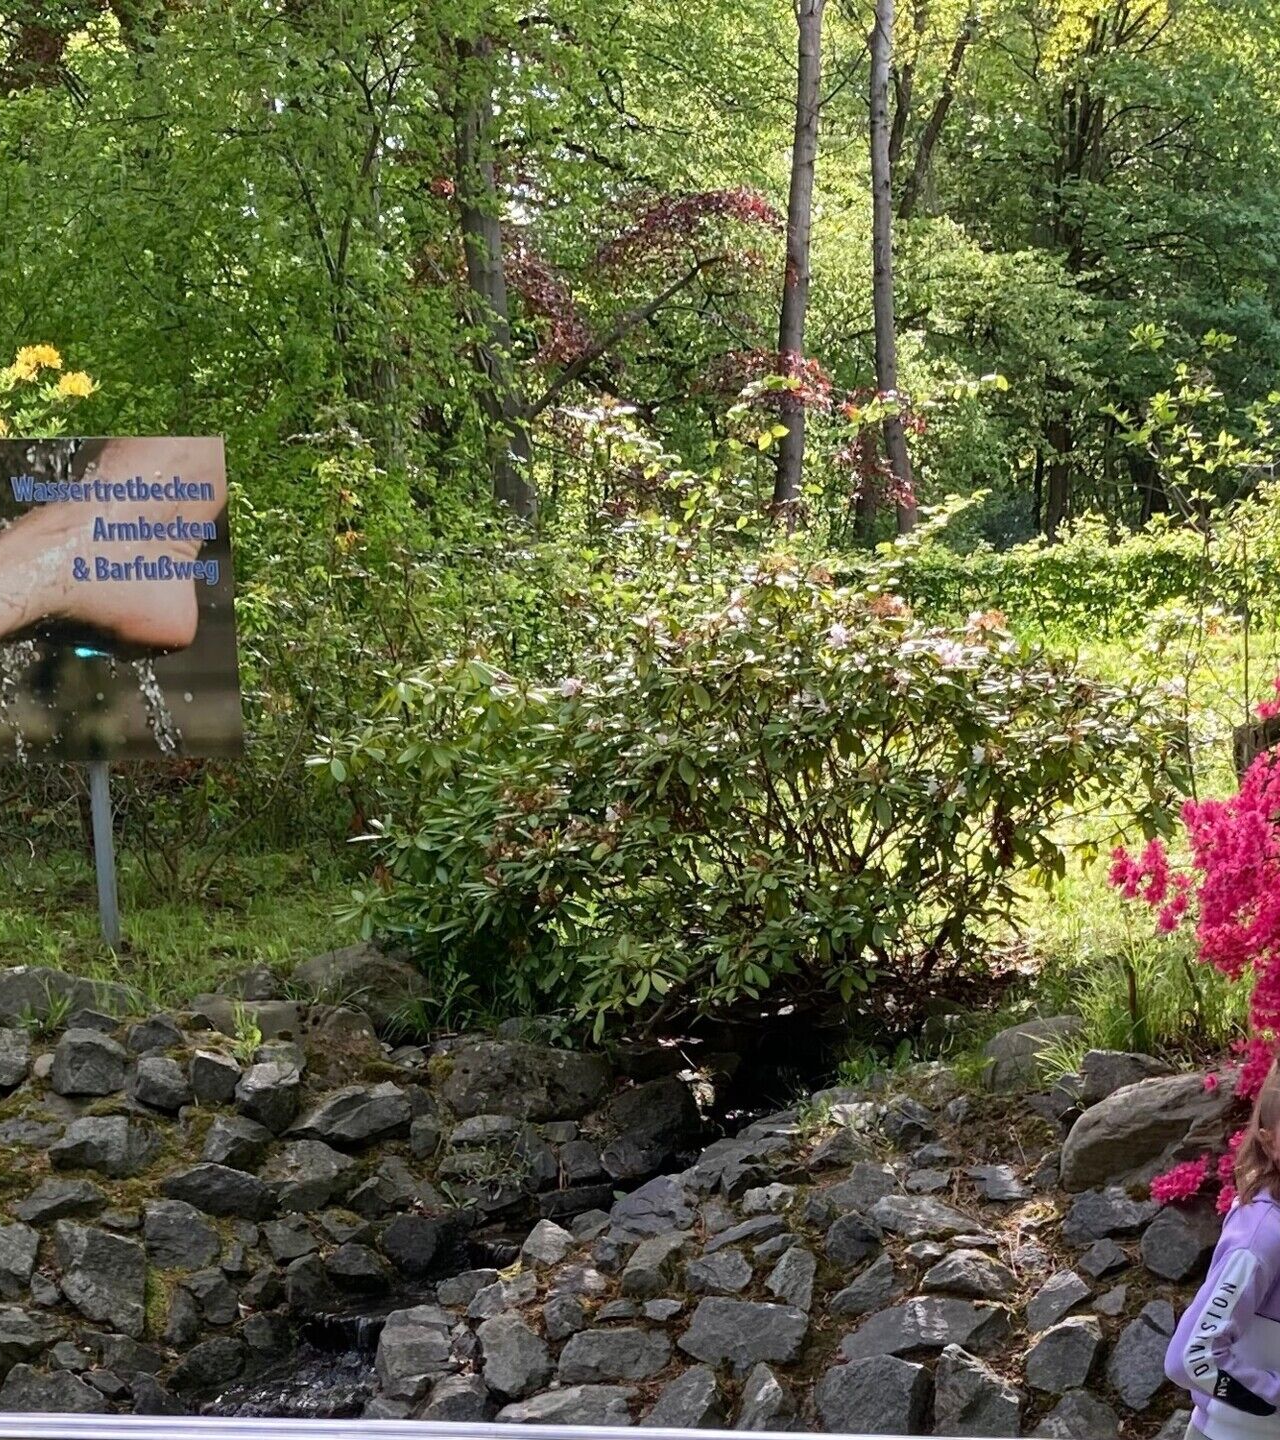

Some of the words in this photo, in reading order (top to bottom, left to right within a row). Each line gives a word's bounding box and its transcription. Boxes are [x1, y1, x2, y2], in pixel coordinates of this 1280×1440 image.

[10, 475, 215, 502] Wassertretbecken
[93, 516, 218, 542] Armbecken
[72, 556, 92, 582] &
[95, 555, 220, 586] Barfußweg
[1189, 1282, 1237, 1377] DIVISION
[1217, 1376, 1231, 1397] NYC
